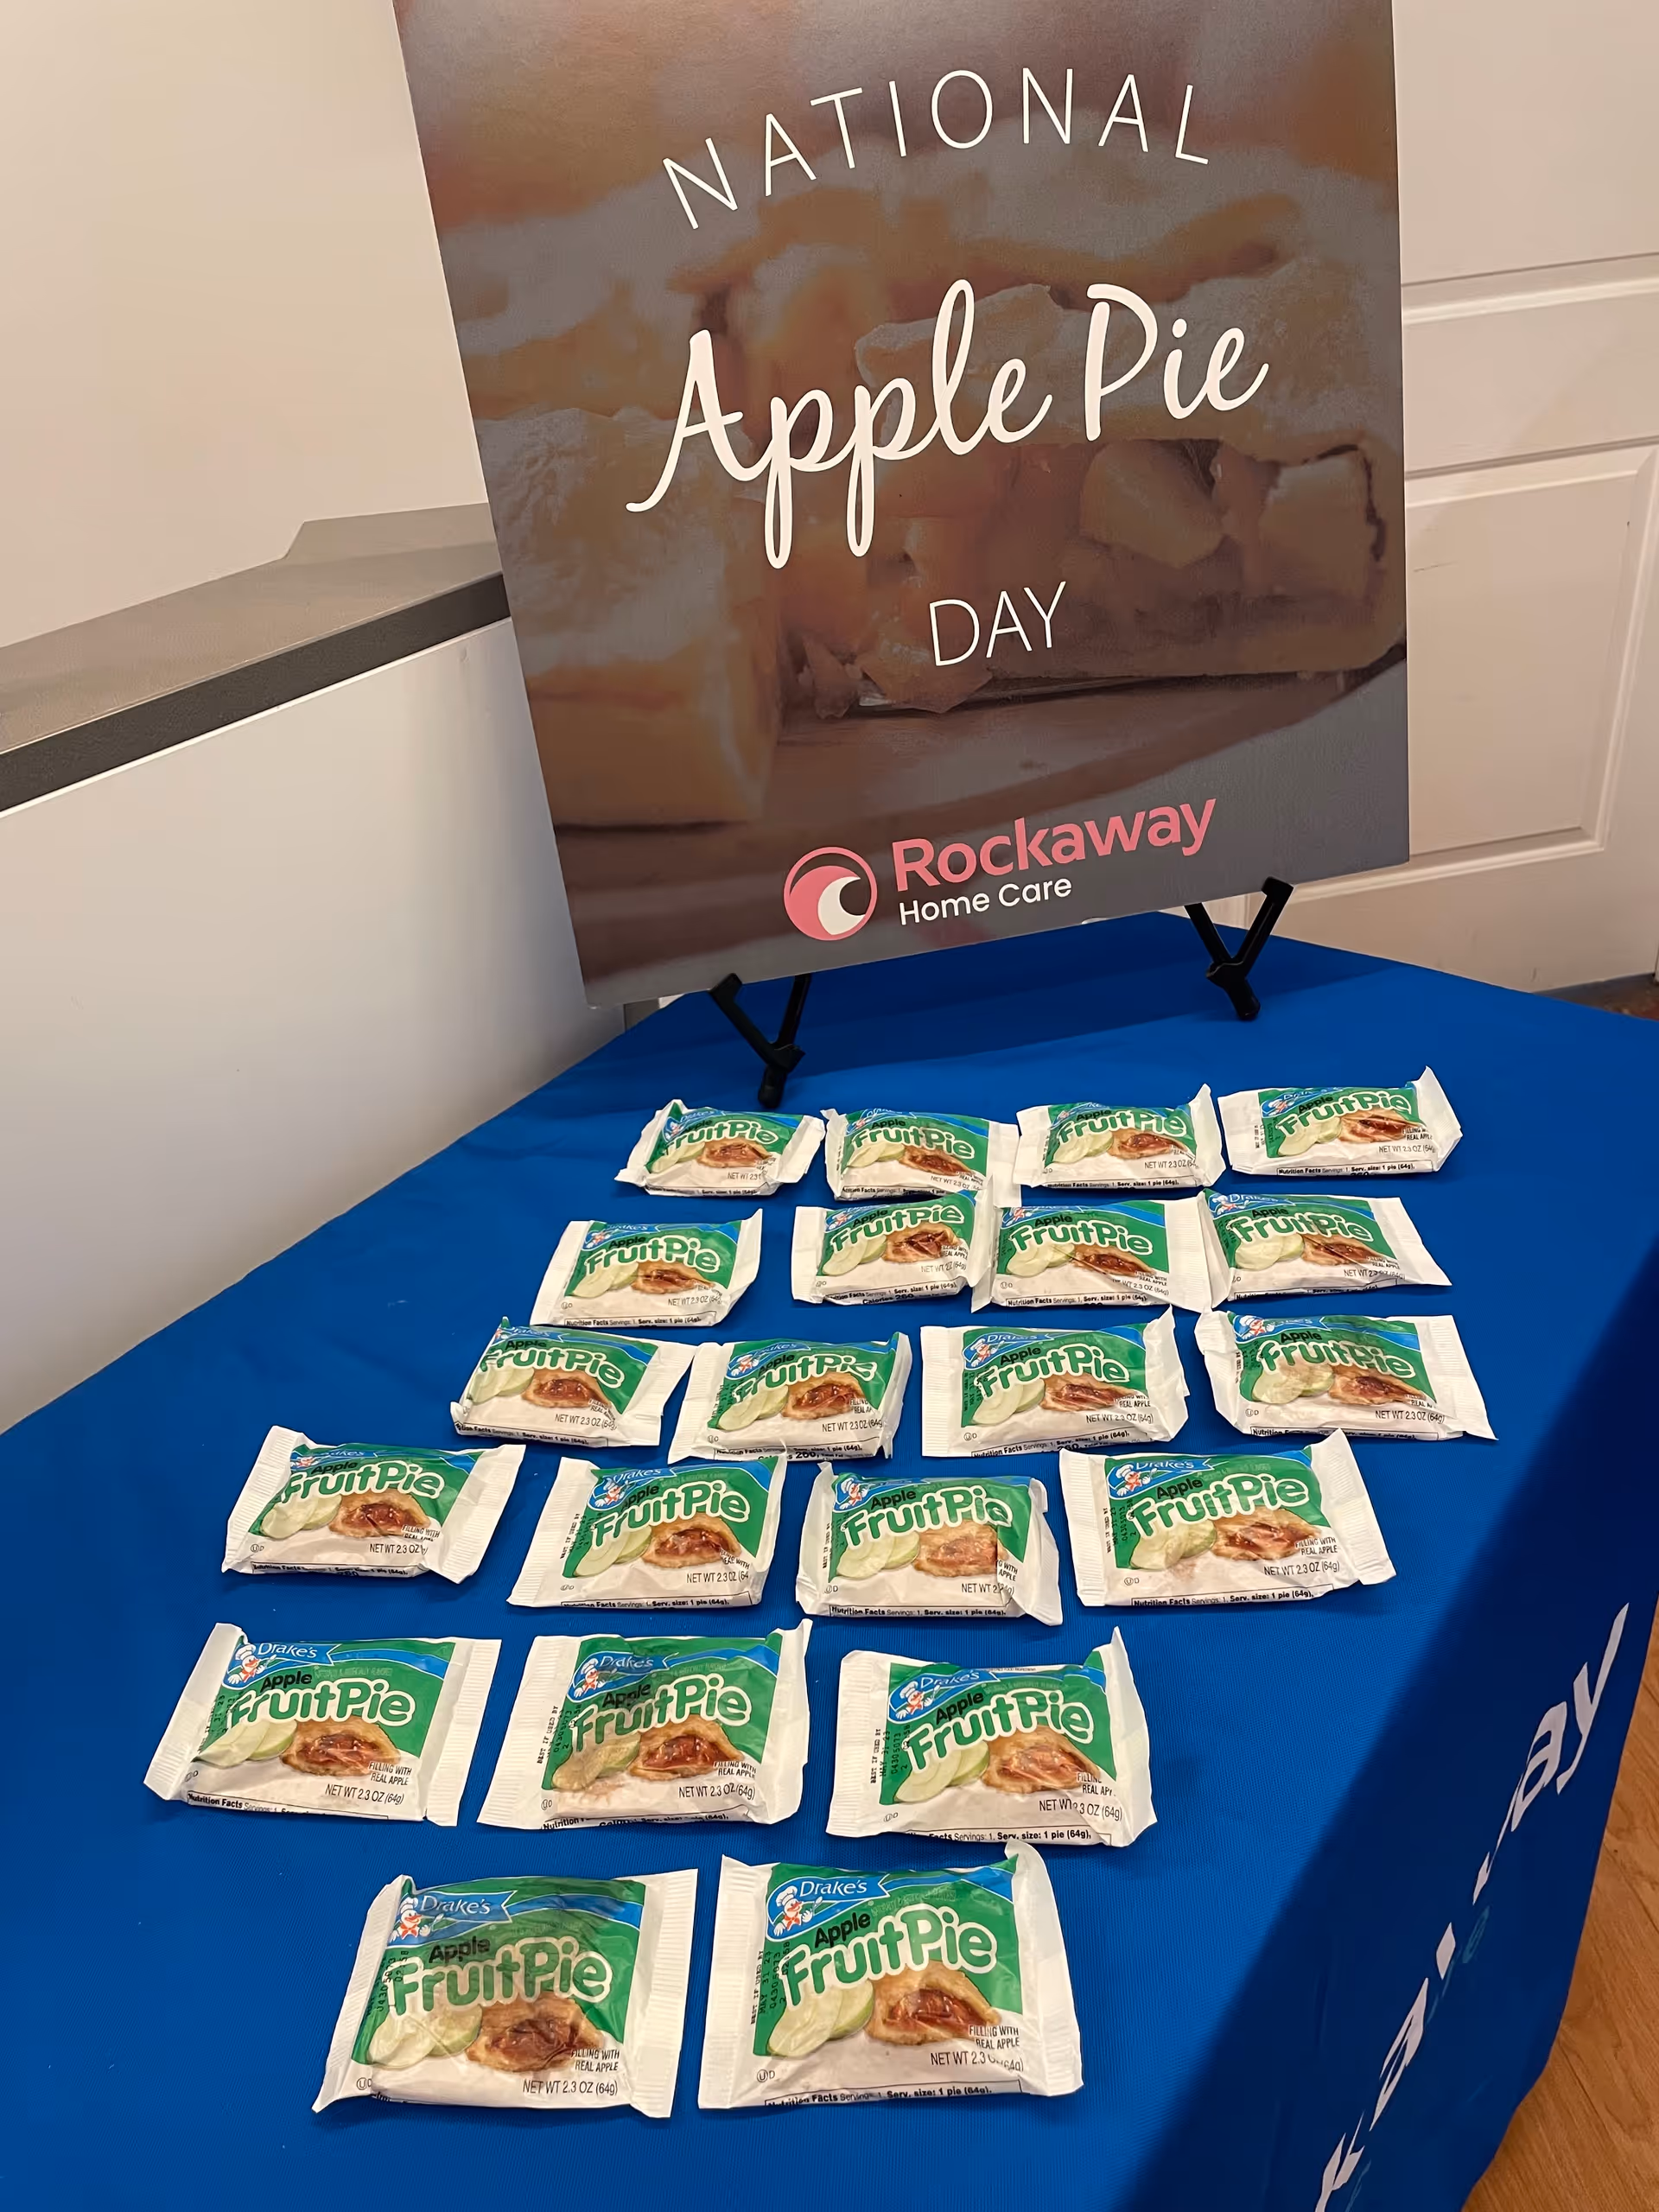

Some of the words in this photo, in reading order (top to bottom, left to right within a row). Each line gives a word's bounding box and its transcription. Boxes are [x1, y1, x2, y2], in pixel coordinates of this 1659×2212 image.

[662, 67, 1209, 229] NATIONAL
[626, 278, 1053, 569] Apple
[1084, 283, 1269, 441] Pie
[930, 582, 1065, 666] DAY
[892, 798, 1217, 892] Rockaway
[899, 892, 990, 925] Home
[999, 877, 1071, 906] Care
[1298, 1096, 1333, 1112] Apple
[1077, 1109, 1112, 1121] Apple
[872, 1119, 906, 1129] Apple
[853, 1210, 887, 1227] Apple
[1252, 1207, 1289, 1217] Apple
[1035, 1214, 1072, 1227] Apple
[609, 1236, 645, 1249] Apple
[1281, 1332, 1321, 1343] Apple
[505, 1340, 547, 1351] Apple
[1000, 1346, 1041, 1364] Apple
[556, 1414, 569, 1423] NET
[569, 1415, 580, 1424] WT
[581, 1416, 590, 1425] 2.3
[591, 1418, 601, 1427] OZ
[1086, 1414, 1101, 1423] NET
[1103, 1414, 1114, 1422] WT
[1138, 1413, 1154, 1424] (64g)
[1376, 1410, 1389, 1419] NET
[1391, 1411, 1404, 1420] WT
[1418, 1412, 1427, 1421] OZ
[1427, 1413, 1445, 1423] (64g)
[823, 1423, 836, 1432] NET
[836, 1422, 849, 1431] WT
[311, 1461, 357, 1474] Apple
[1135, 1459, 1194, 1470] Drake's
[1157, 1478, 1203, 1499] Apple
[870, 1490, 916, 1510] Apple
[370, 1543, 383, 1553] NET
[385, 1543, 396, 1554] WT
[397, 1545, 408, 1554] 2.3
[409, 1544, 420, 1554] OZ
[1295, 1538, 1318, 1548] FILLING
[1319, 1537, 1336, 1546] WITH
[1301, 1546, 1318, 1554] REAL
[1319, 1545, 1338, 1554] APPLE
[1264, 1565, 1280, 1576] NET
[1281, 1565, 1294, 1575] WT
[1296, 1564, 1308, 1574] 2.3
[1310, 1562, 1320, 1573] OZ
[1322, 1561, 1339, 1573] (64g)
[686, 1573, 701, 1583] NET
[702, 1573, 715, 1583] WT
[716, 1572, 728, 1581] 2.3
[729, 1572, 736, 1581] OZ
[961, 1583, 976, 1593] NET
[979, 1583, 992, 1593] WT
[1278, 1592, 1290, 1600] pie
[258, 1642, 317, 1658] Drake's
[599, 1656, 653, 1669] Drake's
[260, 1671, 312, 1692] Apple
[921, 1671, 980, 1687] Drake's
[602, 1683, 652, 1708] Apple
[936, 1692, 983, 1725] Apple
[368, 1763, 394, 1774] FILLING
[395, 1765, 412, 1776] WITH
[714, 1762, 740, 1770] FILLING
[741, 1762, 757, 1773] WITH
[371, 1773, 387, 1784] REAL
[389, 1775, 408, 1786] APPLE
[325, 1783, 341, 1796] NET
[344, 1786, 357, 1797] WT
[358, 1788, 371, 1800] 2.3
[372, 1789, 384, 1802] OZ
[385, 1791, 404, 1804] (64g)
[678, 1787, 696, 1797] NET
[696, 1787, 708, 1797] WT
[710, 1787, 722, 1796] 2.3
[724, 1783, 735, 1794] OZ
[736, 1784, 755, 1801] (64g)
[1082, 1783, 1098, 1796] REAL
[1039, 1799, 1056, 1811] NET
[1087, 1803, 1100, 1815] OZ
[1103, 1803, 1122, 1821] (64g)
[1021, 1832, 1041, 1840] size:
[1051, 1831, 1065, 1841] pie
[799, 1879, 868, 1897] Drake's
[420, 1895, 491, 1915] Drake's
[815, 1913, 871, 1948] Apple
[429, 1936, 490, 1963] Apple
[969, 2024, 996, 2037] FILLING
[998, 2025, 1019, 2036] WITH
[975, 2039, 994, 2050] REAL
[996, 2037, 1020, 2049] APPLE
[571, 2049, 599, 2059] FILLING
[601, 2049, 620, 2059] WITH
[931, 2051, 950, 2065] NET
[952, 2052, 969, 2065] WT
[971, 2051, 985, 2064] 2.3
[575, 2061, 594, 2071] REAL
[596, 2060, 618, 2071] APPLE
[523, 2080, 543, 2093] NET
[545, 2081, 561, 2093] WT
[563, 2080, 577, 2093] 2.3
[580, 2080, 594, 2093] OZ
[595, 2080, 618, 2095] (64g)
